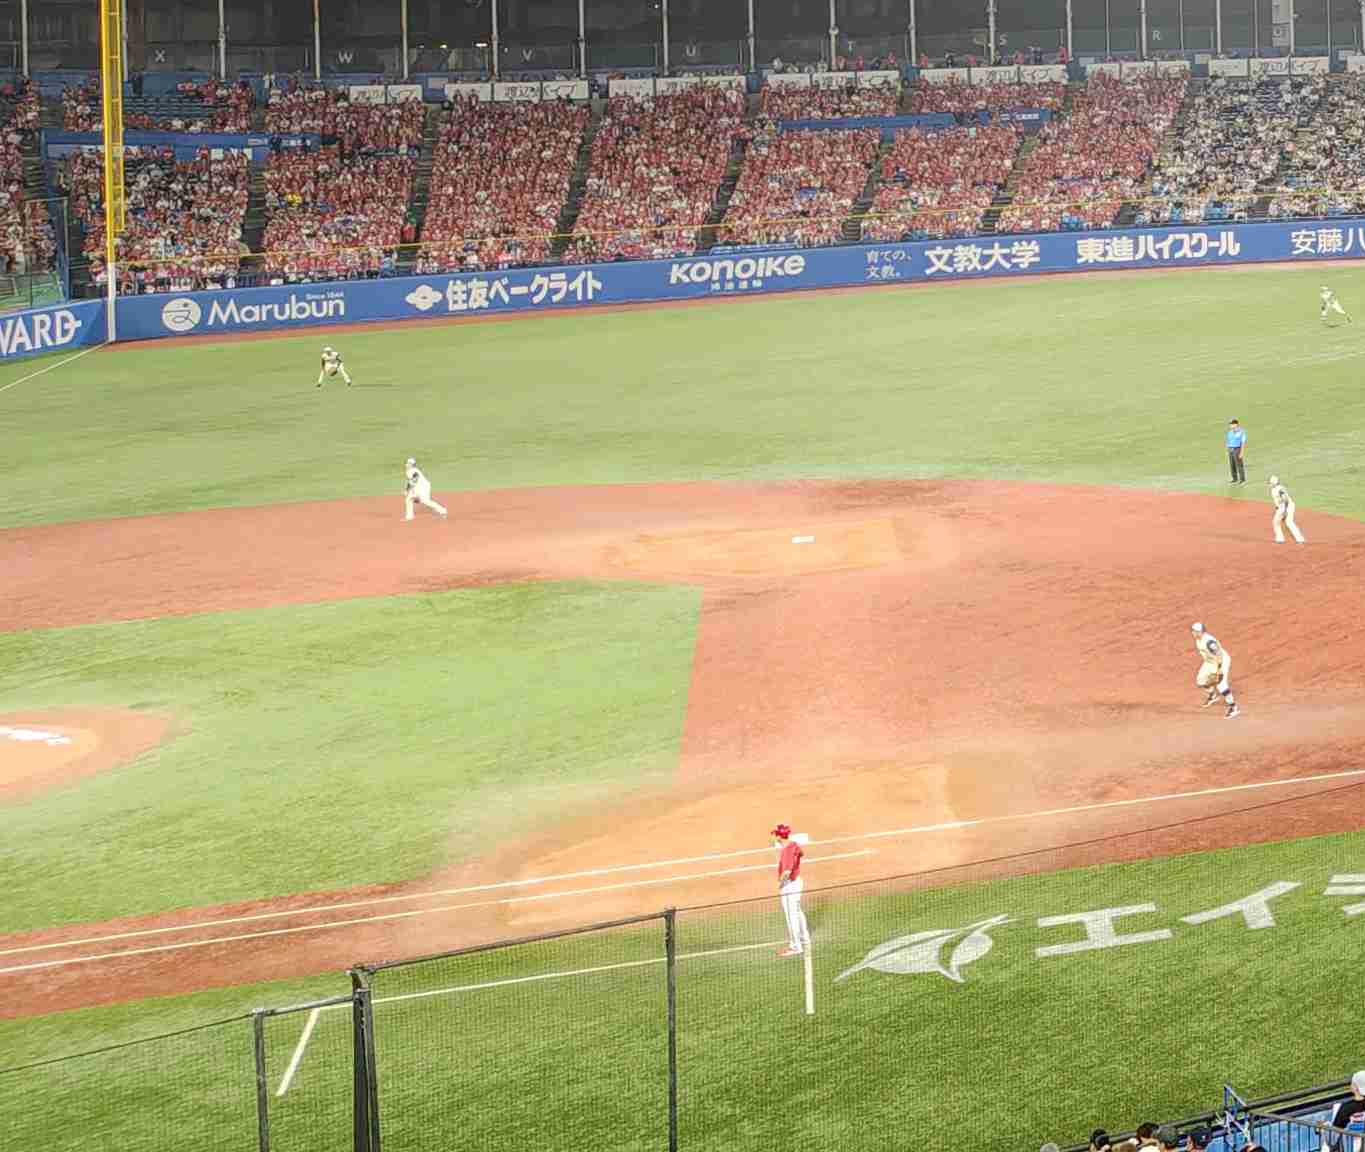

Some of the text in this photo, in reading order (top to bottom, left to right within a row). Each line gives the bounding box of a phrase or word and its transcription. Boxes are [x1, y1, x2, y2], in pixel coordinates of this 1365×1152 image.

[924, 241, 1040, 275] 文教大学
[1077, 231, 1240, 263] 東進ハイスクール
[447, 271, 601, 310] 住友ベークライト
[208, 294, 344, 325] Marubun
